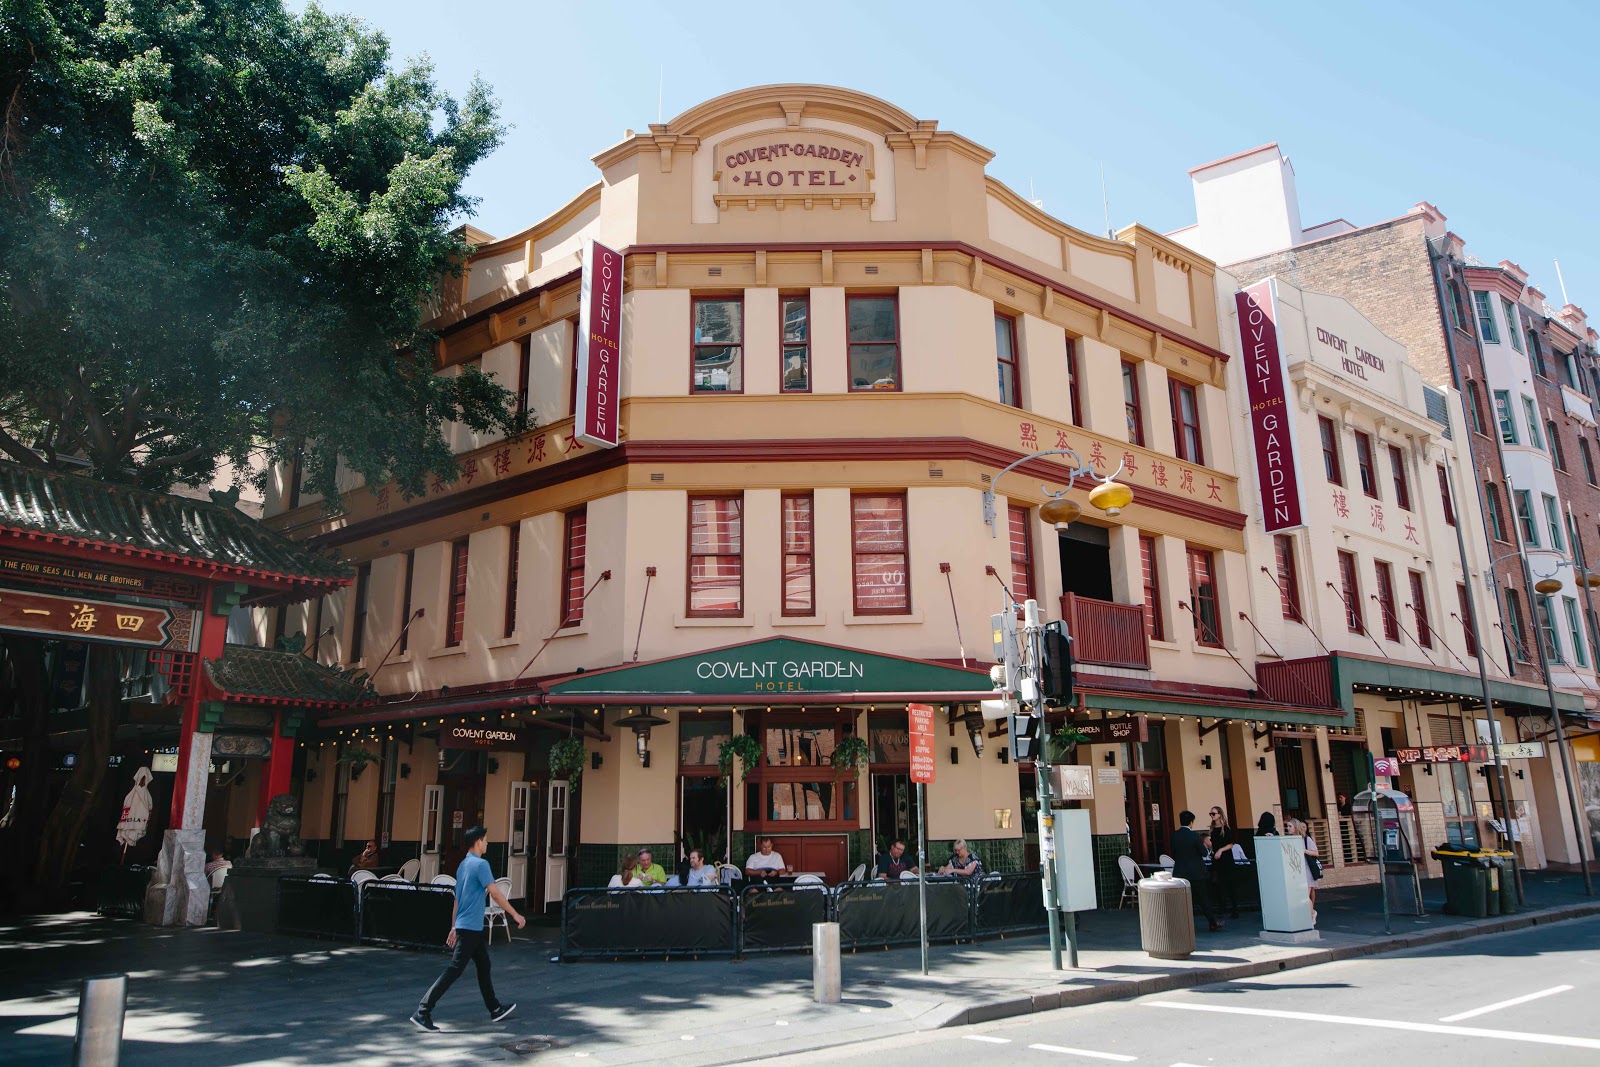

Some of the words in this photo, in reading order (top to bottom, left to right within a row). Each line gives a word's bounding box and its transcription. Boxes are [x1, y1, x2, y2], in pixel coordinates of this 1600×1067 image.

[744, 170, 846, 186] HOTEL
[600, 252, 612, 334] COVENT
[591, 332, 618, 350] HOTEL
[1246, 292, 1271, 394] COVENT
[1316, 326, 1348, 355] COVENT
[1354, 346, 1385, 373] GARDEN
[1341, 356, 1368, 382] HOTEL
[596, 349, 610, 436] GARDEN
[1252, 398, 1284, 412] HOTEL
[1263, 414, 1290, 524] GARDEN
[4, 560, 18, 570] THE
[20, 562, 40, 572] FOUR
[42, 566, 60, 576] SEAS
[62, 568, 76, 578] ALL
[78, 570, 92, 580] MEN
[94, 572, 108, 582] ARE
[110, 575, 142, 587] BROTHERS
[0, 597, 144, 632] 四海一
[696, 661, 778, 678] COVENT
[782, 661, 864, 678] GARDEN
[755, 682, 804, 690] HOTEL
[914, 716, 930, 724] PARKING
[1110, 722, 1132, 730] BOTTLE
[452, 728, 484, 738] COVENT
[486, 730, 516, 740] GARDEN
[1076, 726, 1100, 734] GARDEN
[1397, 750, 1420, 763] VIP
